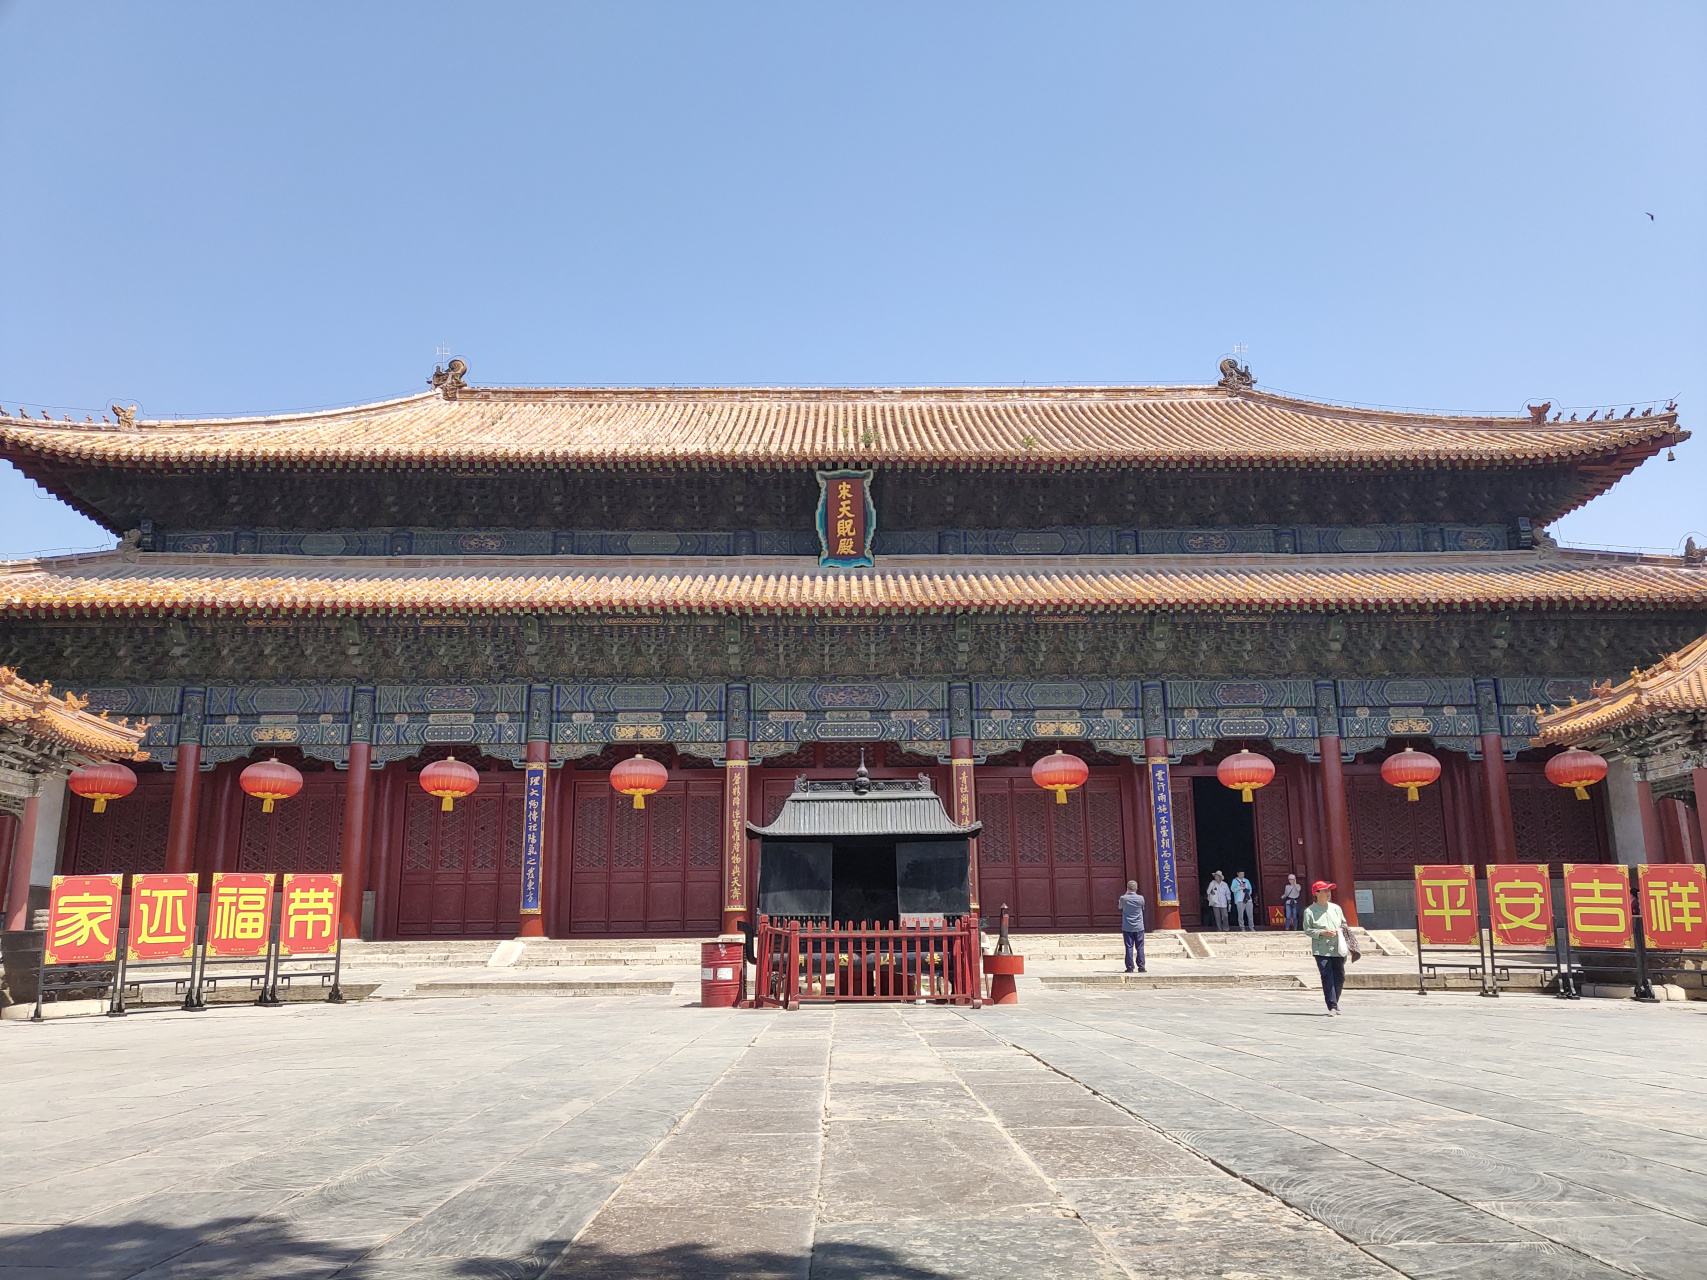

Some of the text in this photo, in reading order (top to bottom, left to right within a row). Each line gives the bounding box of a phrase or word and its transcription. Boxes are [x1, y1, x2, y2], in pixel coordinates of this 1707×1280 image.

[836, 481, 857, 555] 宋天貺殿
[54, 892, 113, 947] 家
[214, 887, 267, 940] 福
[288, 888, 334, 940] 带
[1275, 907, 1283, 917] 入
[1421, 879, 1472, 931] 平
[1494, 879, 1548, 931] 安
[1570, 879, 1626, 933] 吉
[1647, 881, 1703, 932] 祥
